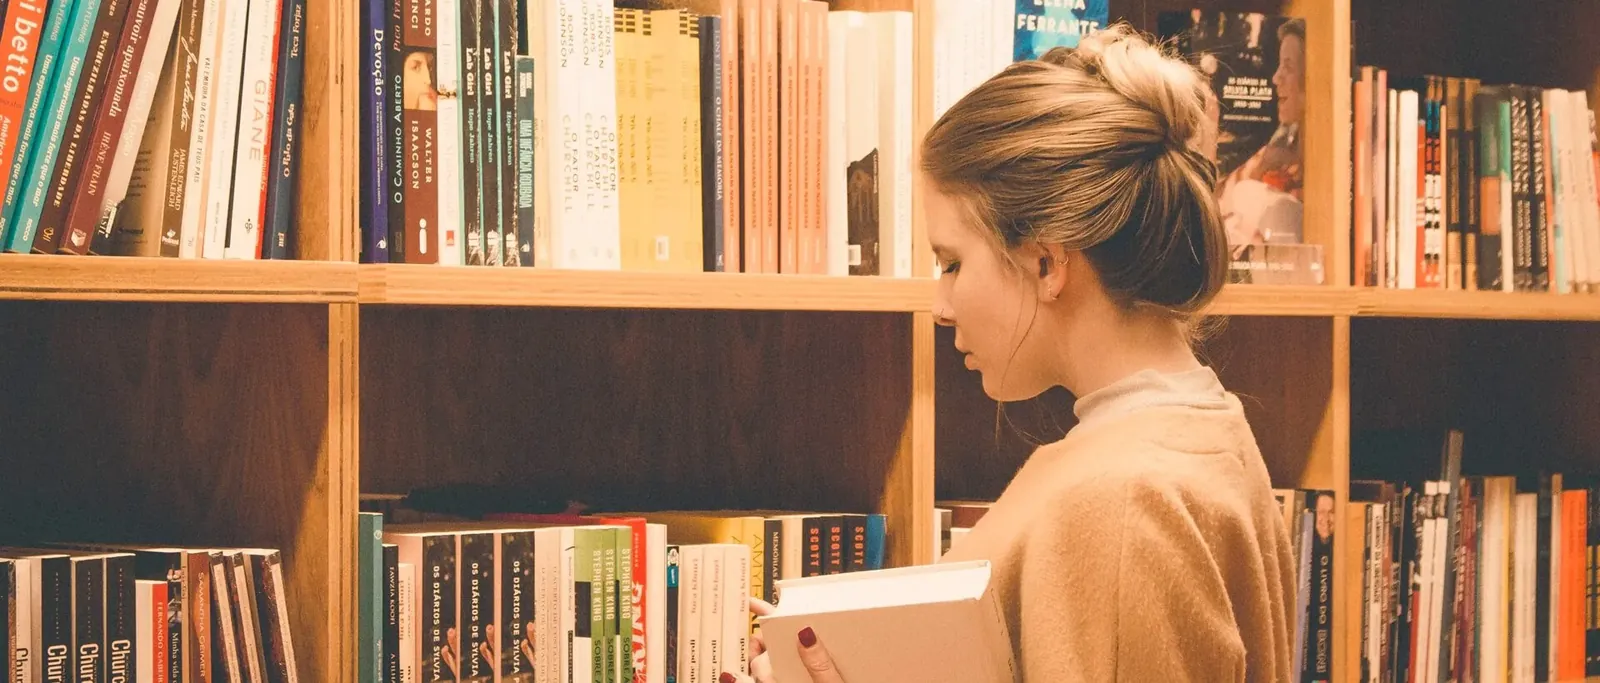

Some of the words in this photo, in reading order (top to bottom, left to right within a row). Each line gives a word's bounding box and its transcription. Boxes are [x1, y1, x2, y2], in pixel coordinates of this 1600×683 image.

[292, 4, 303, 33] Forjaz
[1017, 13, 1099, 38] FERRANTE
[559, 0, 567, 68] JOHNSON
[567, 14, 575, 55] BORIS
[582, 0, 590, 66] JOHNSON
[589, 13, 597, 53] BORIS
[604, 16, 612, 56] BORIS
[3, 17, 38, 93] betto
[290, 36, 300, 58] Teca
[484, 47, 492, 70] Lab
[42, 54, 53, 75] Uma
[69, 56, 80, 79] Uma
[371, 28, 384, 96] Devoção
[503, 51, 511, 73] Lab
[79, 30, 110, 123] ENCRUZILHADAS
[108, 44, 135, 118] apaixonada
[201, 70, 210, 100] EMBORA
[466, 72, 474, 96] Girl
[484, 72, 493, 96] Girl
[504, 76, 512, 99] Girl
[29, 74, 45, 119] esperança
[56, 77, 73, 121] esperança
[200, 101, 207, 112] DA
[716, 97, 722, 105] O
[197, 113, 206, 133] CASA
[249, 79, 267, 160] GIANE
[286, 103, 295, 126] Gata
[24, 118, 34, 141] mais
[50, 120, 61, 143] mais
[73, 123, 83, 139] DA
[286, 128, 294, 142] da
[520, 119, 532, 138] UMA
[571, 133, 578, 142] O
[593, 130, 600, 140] O
[608, 132, 615, 142] O
[18, 140, 29, 163] forte
[43, 141, 56, 165] forte
[195, 147, 203, 165] TEUS
[411, 120, 420, 189] ISAACSON
[425, 128, 433, 184] WALTER
[520, 138, 533, 173] INFÂNCIA
[717, 139, 723, 152] DA
[13, 162, 21, 179] que
[39, 163, 48, 181] que
[178, 148, 187, 174] JAMES
[283, 167, 291, 178] O
[562, 114, 573, 214] CHURCHILL
[584, 112, 595, 212] CHURCHILL
[600, 115, 610, 211] CHURCHILL
[608, 148, 616, 191] FATOR
[11, 179, 17, 187] o
[38, 180, 44, 189] o
[53, 141, 77, 208] LIBERDADE
[87, 163, 103, 197] FRAIN
[5, 186, 15, 206] mar
[32, 188, 42, 207] mar
[174, 174, 185, 211] EDWARD
[394, 192, 403, 203] O
[519, 172, 533, 209] ROUBADA
[772, 531, 780, 577] MEMÓRIAS
[810, 528, 819, 567] SCOTT
[831, 526, 840, 566] SCOTT
[854, 526, 864, 565] SCOTT
[433, 565, 440, 578] OS
[471, 562, 478, 575] OS
[513, 560, 520, 573] OS
[592, 550, 601, 594] STEPHEN
[605, 549, 615, 593] STEPHEN
[621, 548, 631, 592] STEPHEN
[1320, 555, 1329, 564] O
[1319, 567, 1329, 601] LIVRO
[198, 572, 206, 631] SAMANTHA
[433, 582, 441, 626] DIÁRIOS
[471, 579, 480, 621] DIÁRIOS
[513, 577, 522, 620] DIÁRIOS
[592, 597, 602, 622] KING
[605, 595, 615, 620] KING
[621, 594, 631, 619] KING
[1319, 605, 1328, 625] DO
[433, 629, 440, 642] DE
[472, 625, 479, 638] DE
[513, 623, 520, 636] DE
[47, 644, 68, 683] Chur
[172, 660, 180, 678] vida
[471, 642, 479, 677] SYLVIA
